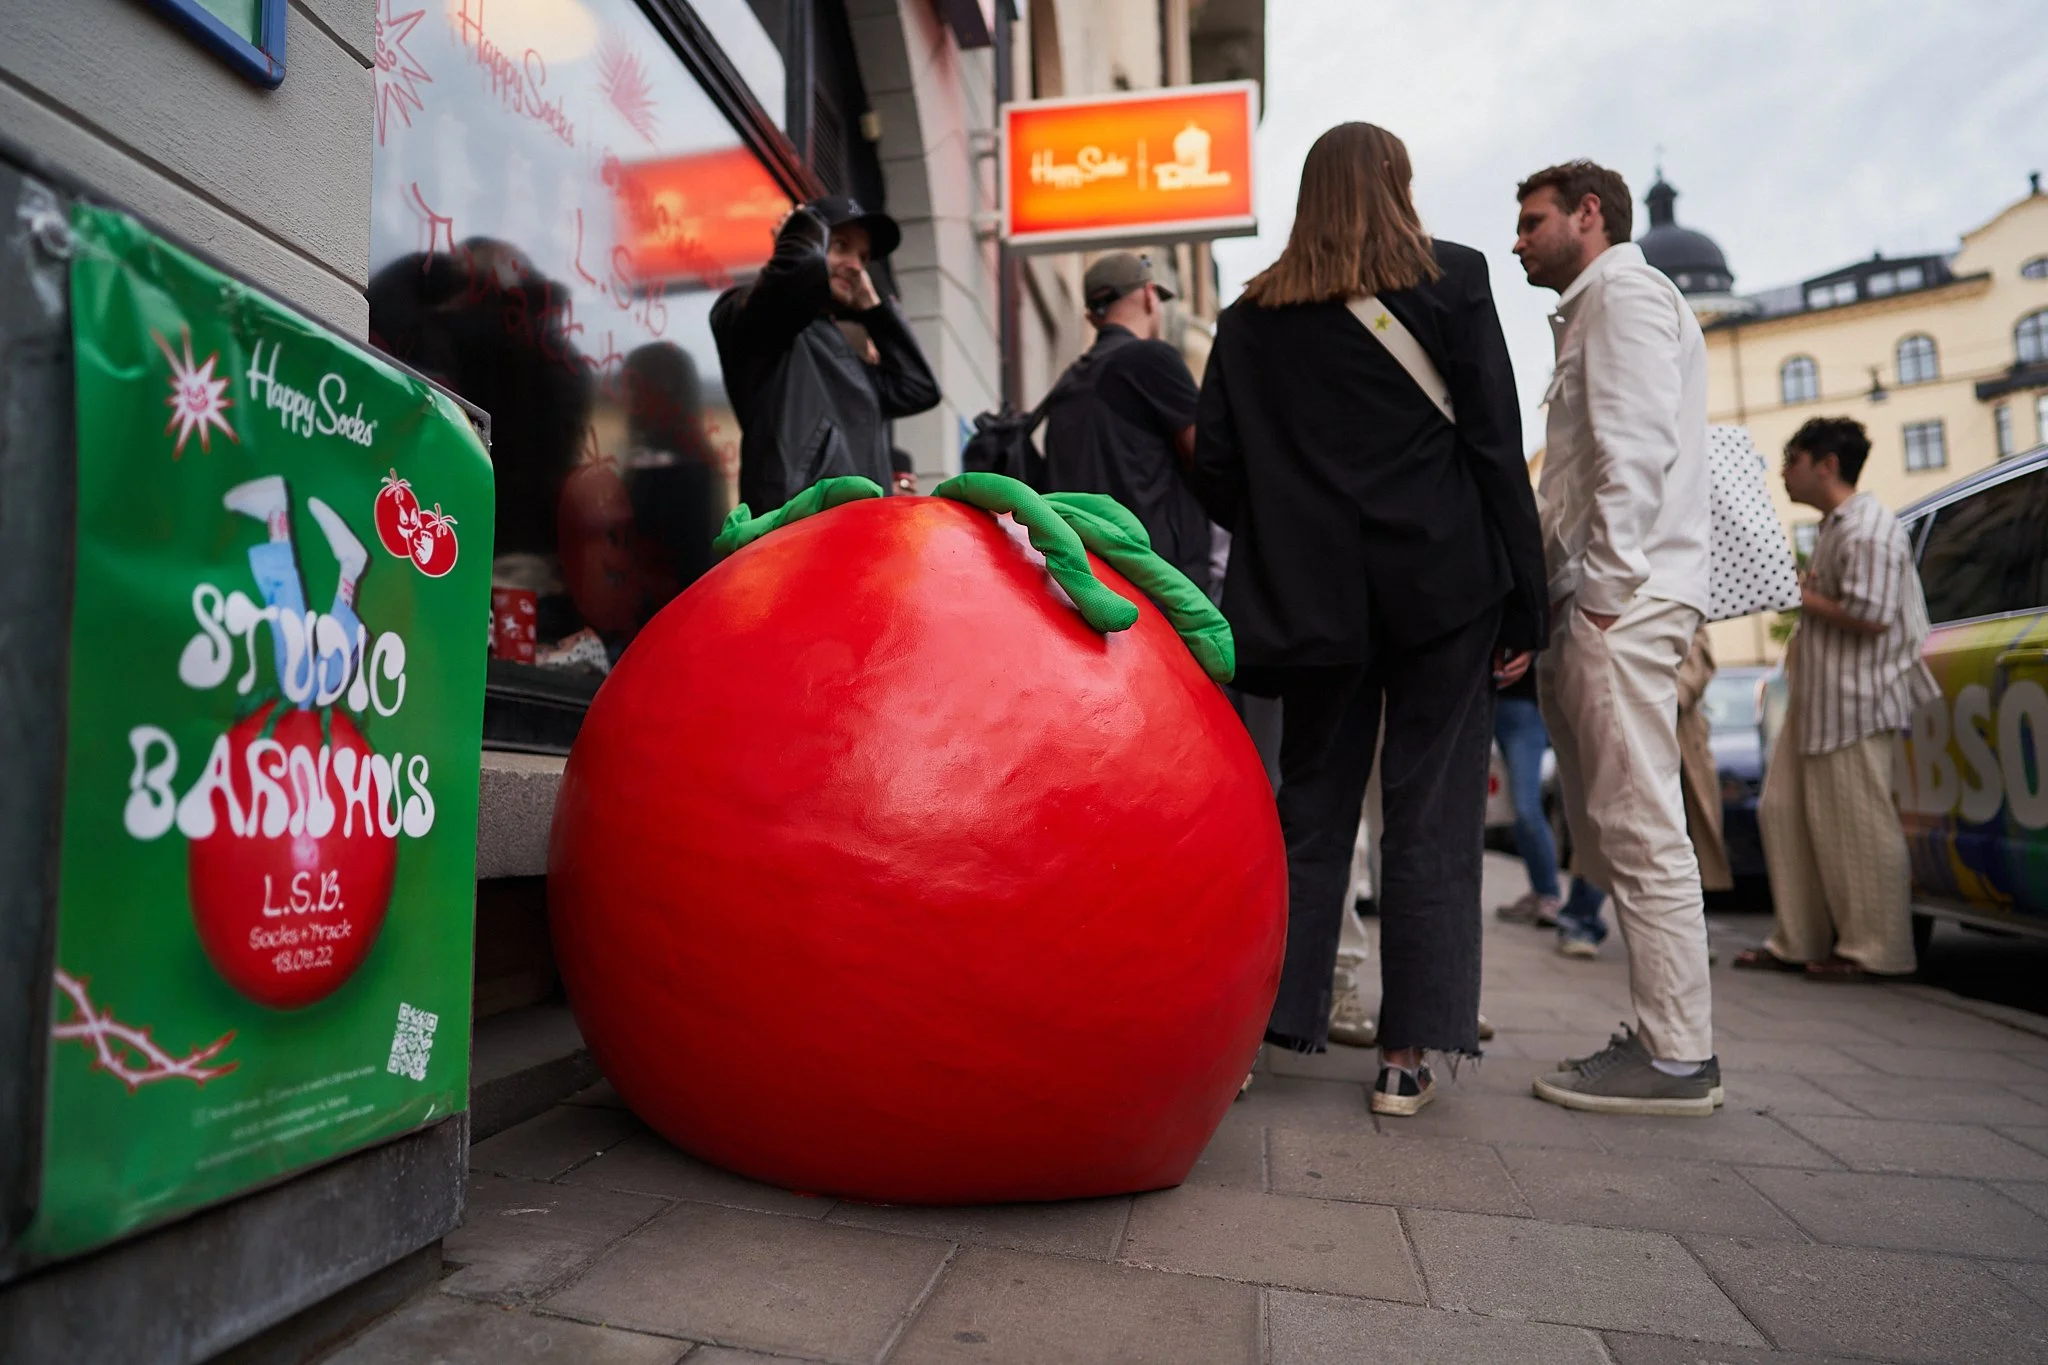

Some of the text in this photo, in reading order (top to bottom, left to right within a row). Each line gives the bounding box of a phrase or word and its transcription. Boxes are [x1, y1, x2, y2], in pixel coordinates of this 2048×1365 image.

[246, 337, 374, 447] Happy Socks
[123, 725, 436, 839] BARNHUS
[262, 870, 345, 917] L.S.B.
